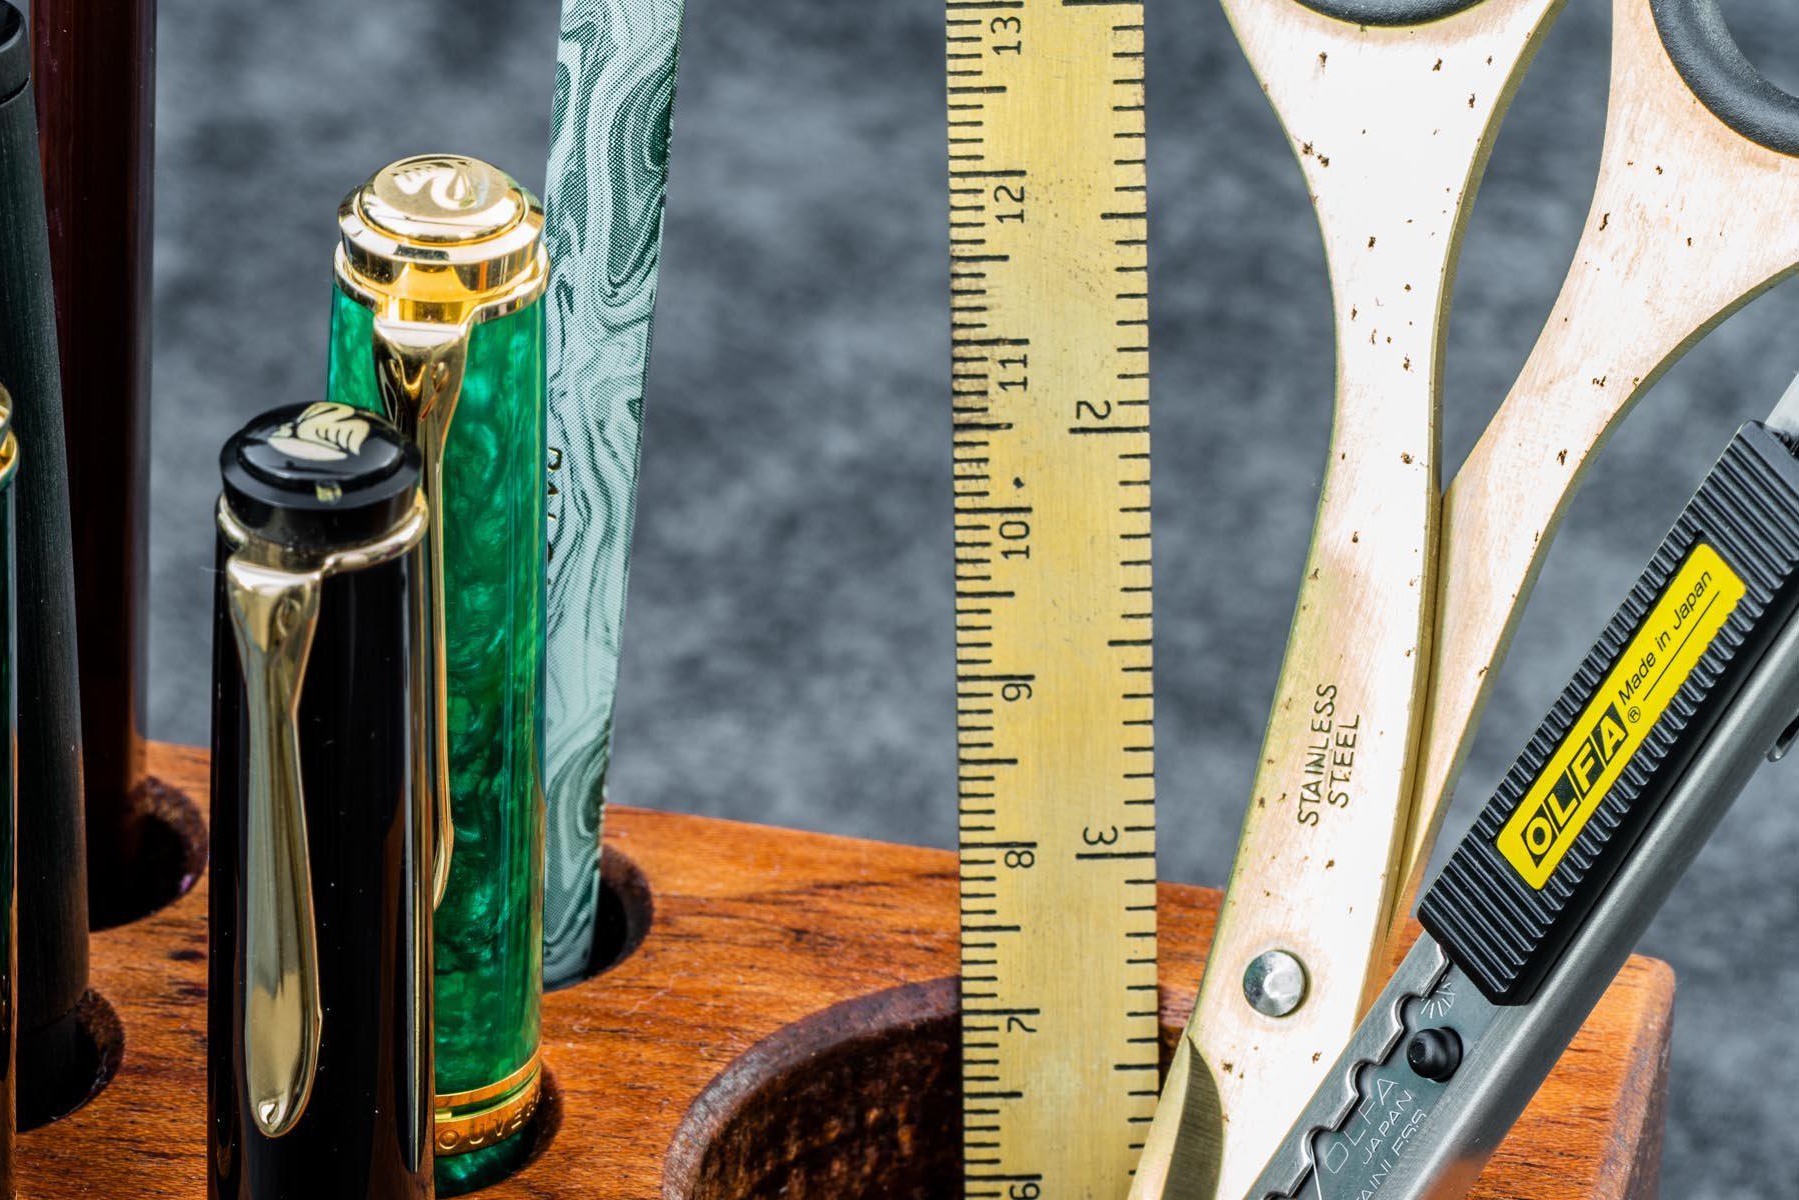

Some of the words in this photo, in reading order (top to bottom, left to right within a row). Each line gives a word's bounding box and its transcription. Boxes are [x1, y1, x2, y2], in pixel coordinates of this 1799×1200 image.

[990, 16, 1022, 55] 13
[993, 185, 1025, 224] 12
[997, 354, 1028, 392] 11
[1076, 400, 1111, 420] 2
[999, 520, 1031, 560] 10
[1617, 651, 1657, 705] Made
[1654, 632, 1671, 651] in
[1673, 570, 1713, 630] Japan
[1001, 683, 1033, 702] 9
[1297, 684, 1337, 827] STAINLESS
[1327, 714, 1360, 808] STEEL
[1522, 707, 1628, 863] OLFA
[1082, 825, 1118, 846] 3
[1004, 850, 1035, 869] 8
[1007, 1016, 1038, 1033] 7
[1324, 1077, 1400, 1174] OLFA
[1362, 1089, 1414, 1165] JAPAN
